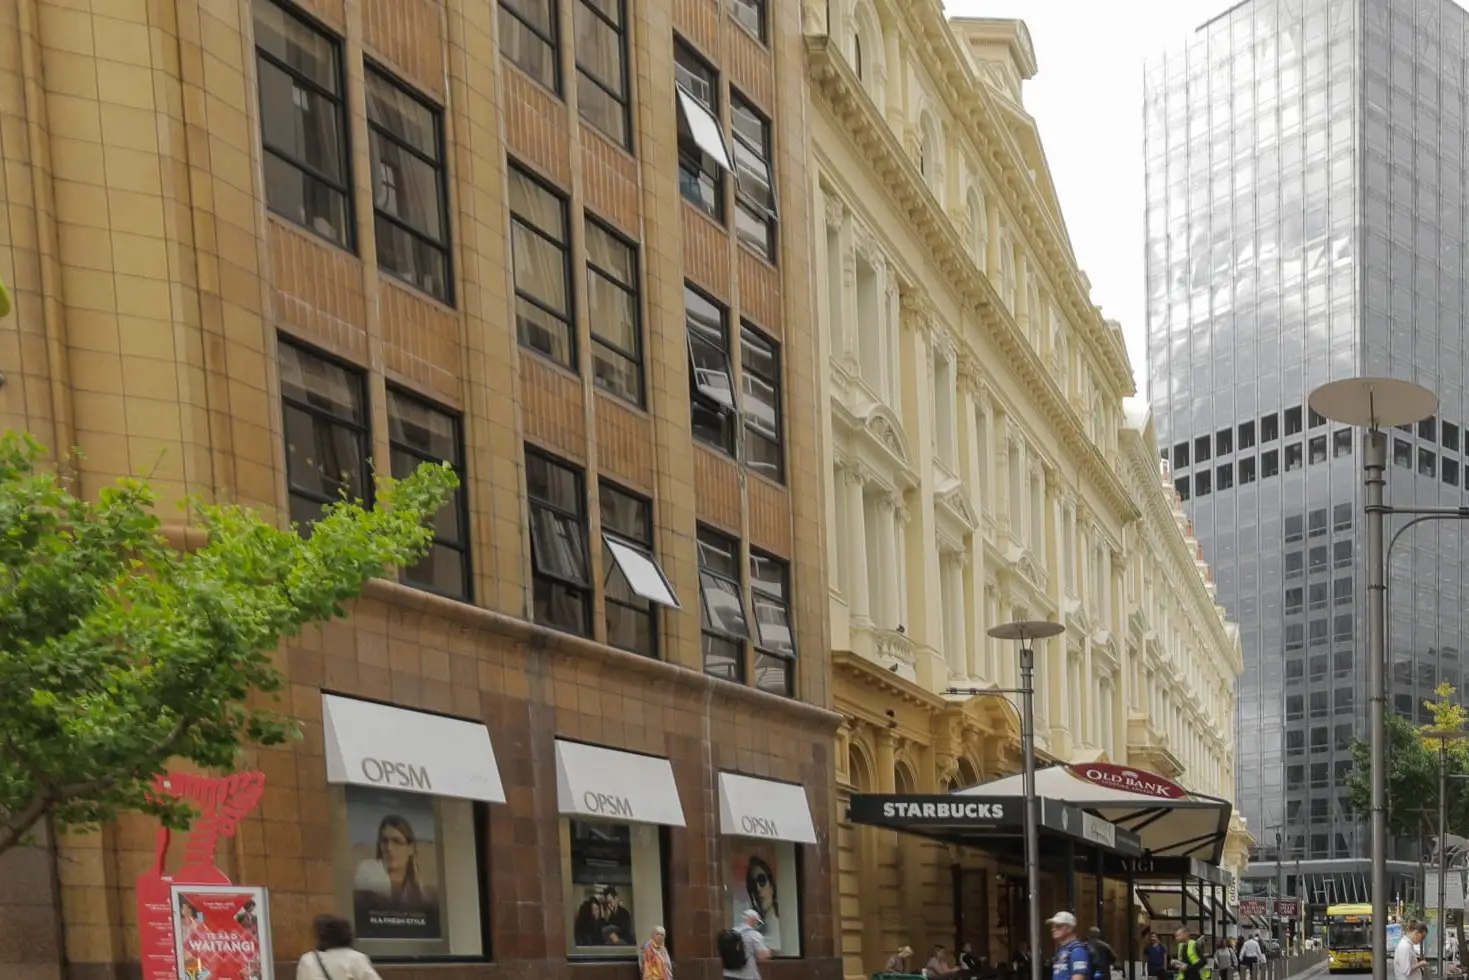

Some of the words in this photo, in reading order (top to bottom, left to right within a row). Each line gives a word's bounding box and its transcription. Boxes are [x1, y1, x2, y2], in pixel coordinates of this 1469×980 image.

[361, 757, 432, 790] OPSM
[1086, 769, 1123, 783] OLD
[1126, 777, 1171, 797] BANK
[583, 790, 633, 817] OPSM
[883, 802, 1004, 819] STARBUCKS
[741, 815, 779, 837] OPSM
[189, 940, 255, 952] WAITANGI
